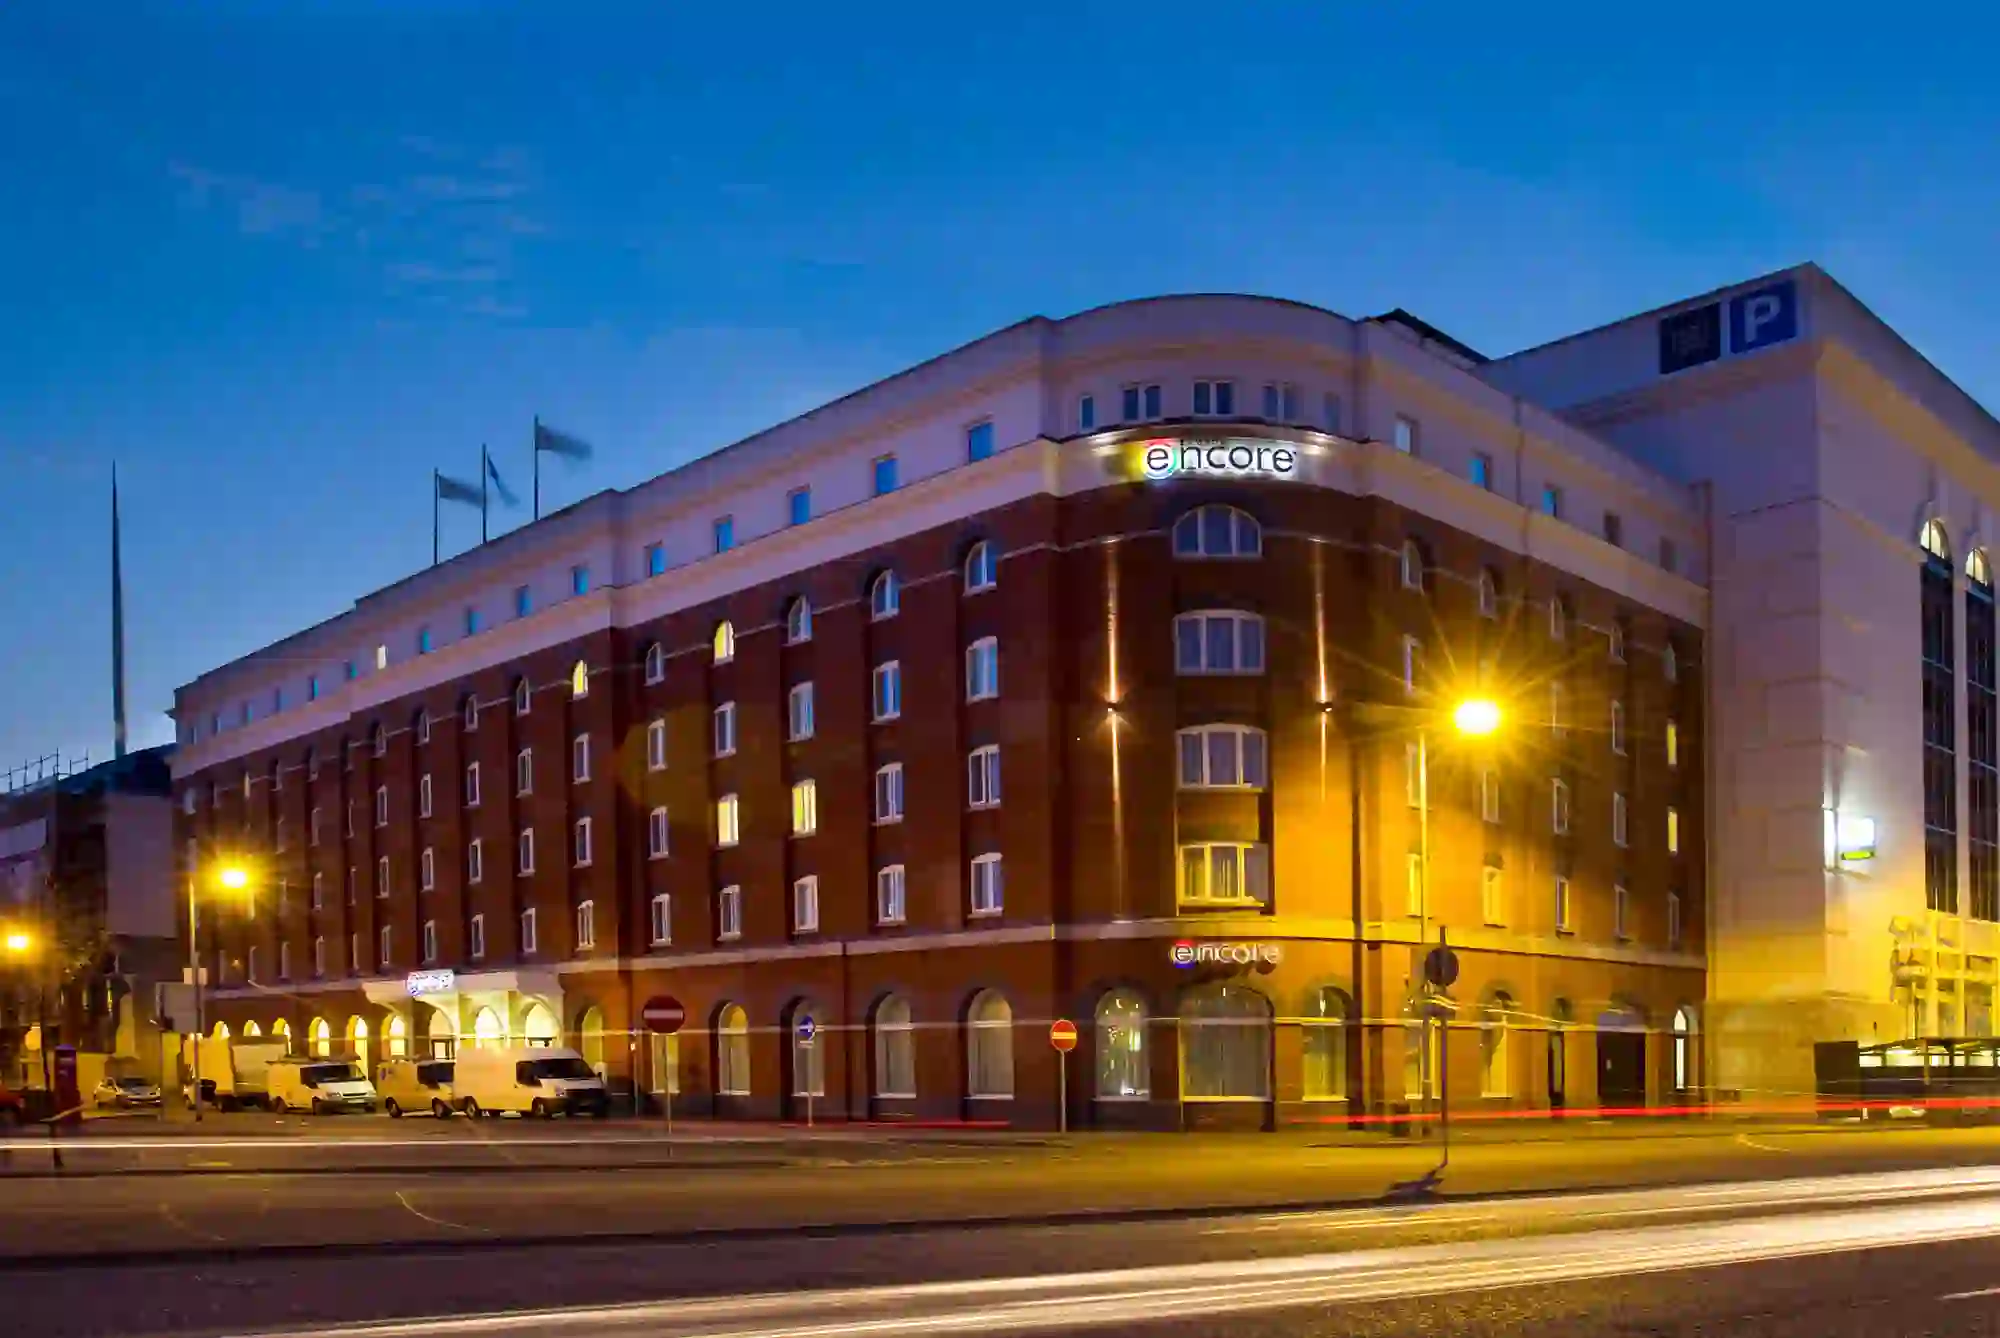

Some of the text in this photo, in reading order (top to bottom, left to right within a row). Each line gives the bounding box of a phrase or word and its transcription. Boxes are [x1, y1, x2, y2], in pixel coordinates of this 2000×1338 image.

[1744, 294, 1781, 344] P
[1146, 445, 1295, 473] encore
[1174, 942, 1281, 964] encore
